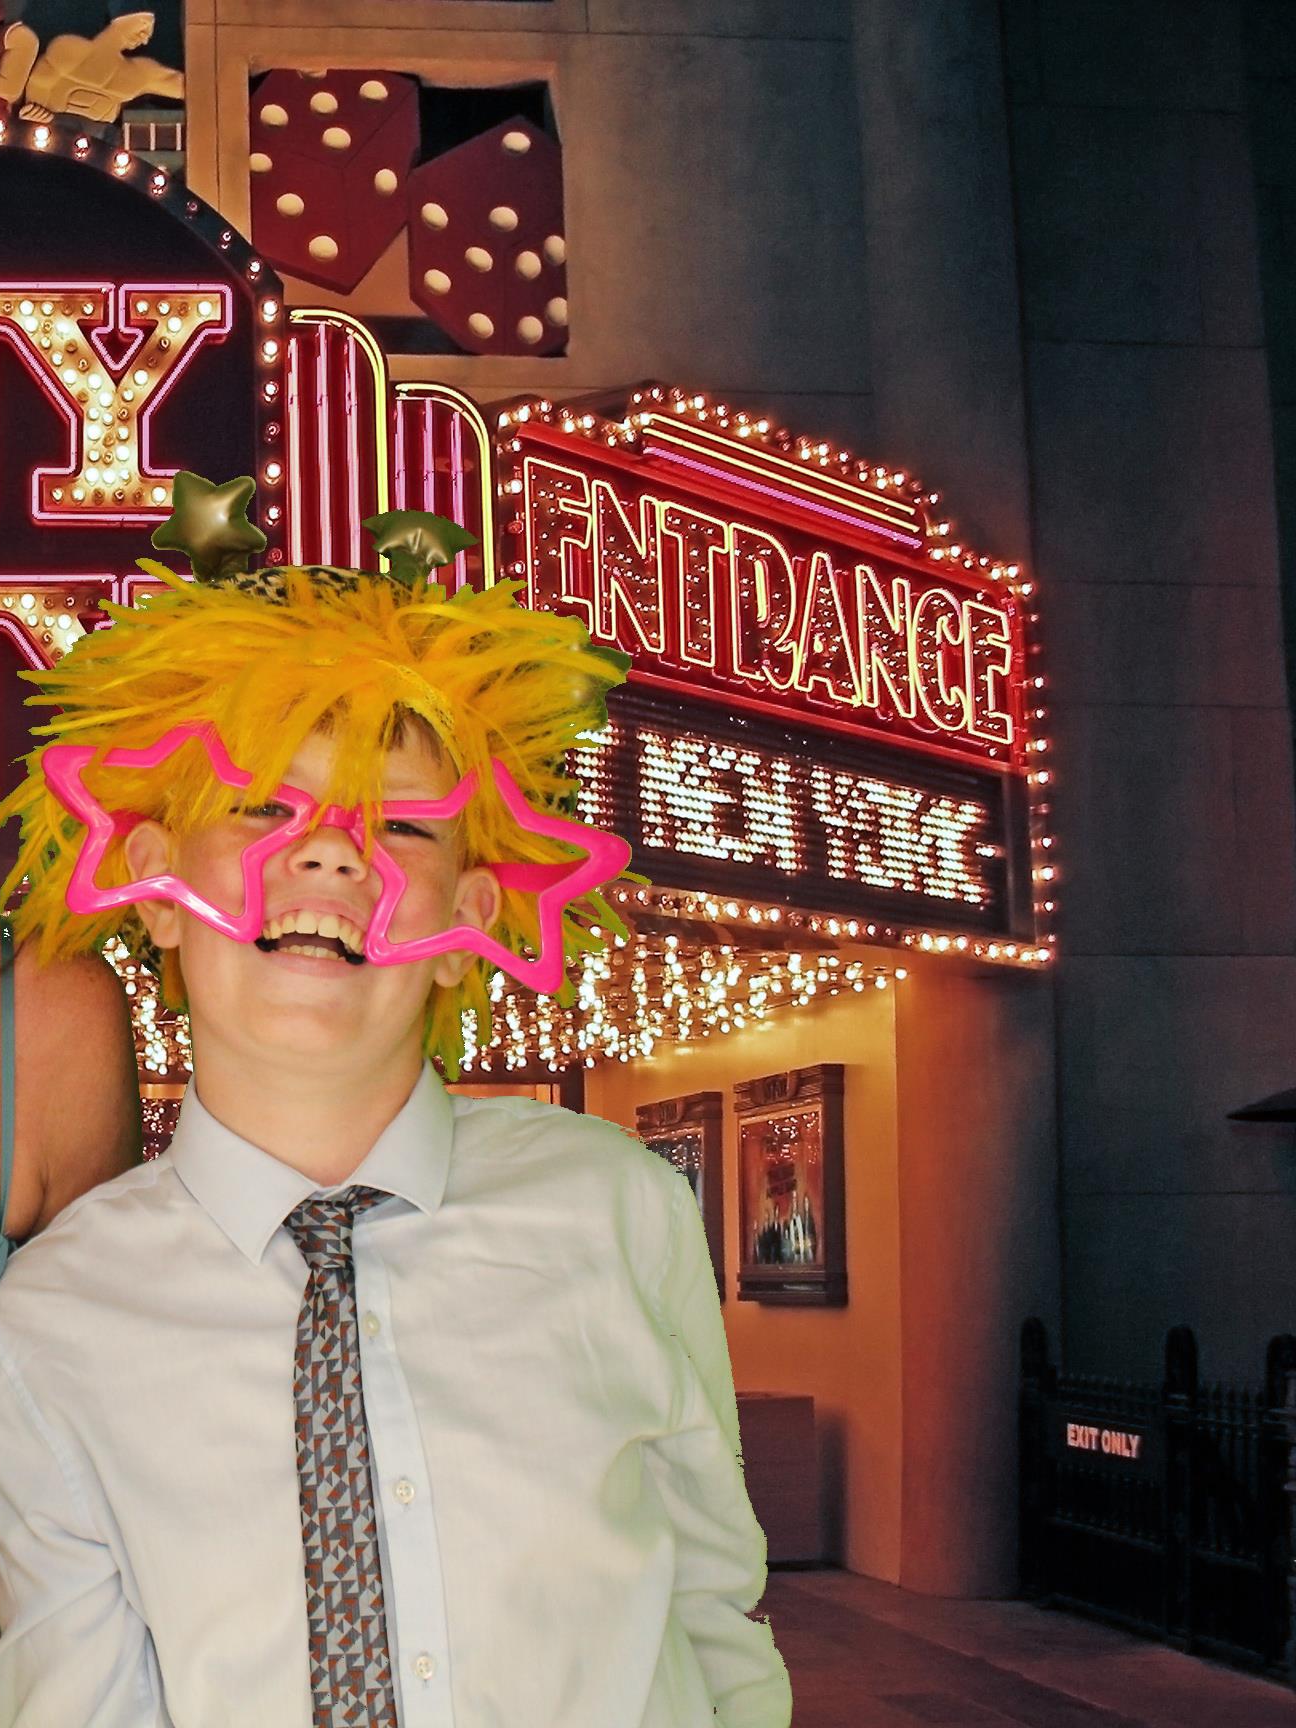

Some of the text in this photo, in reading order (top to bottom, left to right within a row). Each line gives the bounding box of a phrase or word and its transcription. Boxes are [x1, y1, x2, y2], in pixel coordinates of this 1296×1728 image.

[523, 456, 1015, 746] ENTRANCE
[1066, 1422, 1141, 1459] EXIT ONLY
